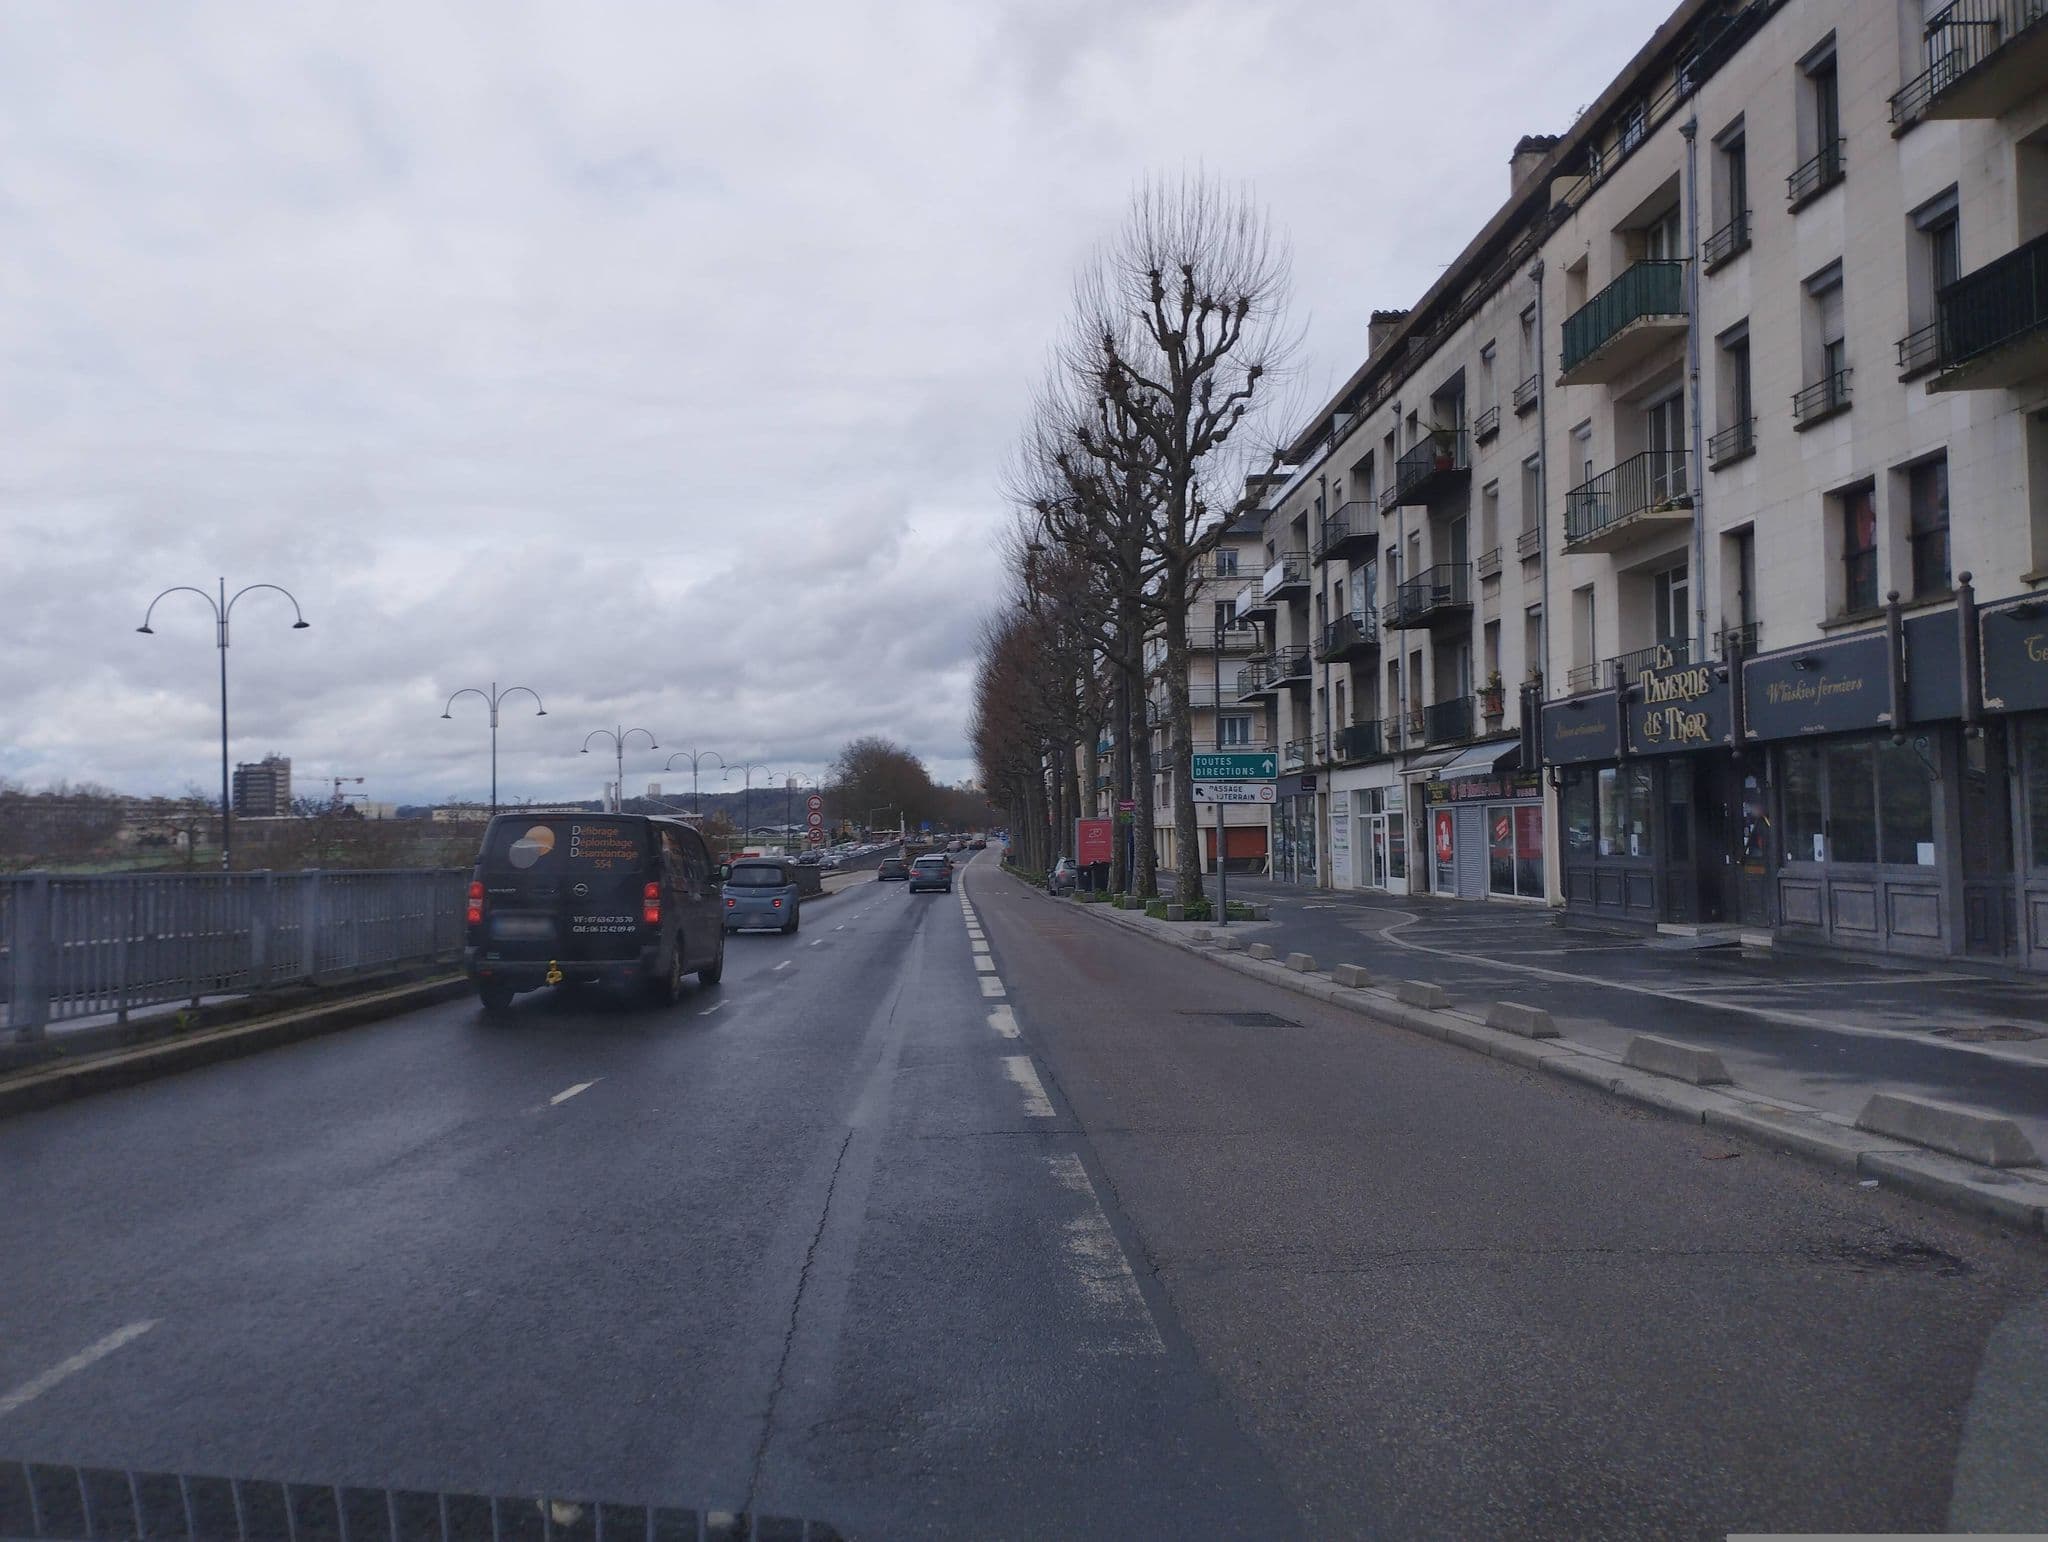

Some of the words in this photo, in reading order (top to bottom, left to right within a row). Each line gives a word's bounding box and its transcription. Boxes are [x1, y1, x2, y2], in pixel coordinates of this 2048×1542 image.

[1768, 680, 1816, 704] Whiskies
[1814, 675, 1864, 705] fermiers
[1195, 757, 1232, 766] TOUTES
[1195, 767, 1255, 776] DIRECTIONS
